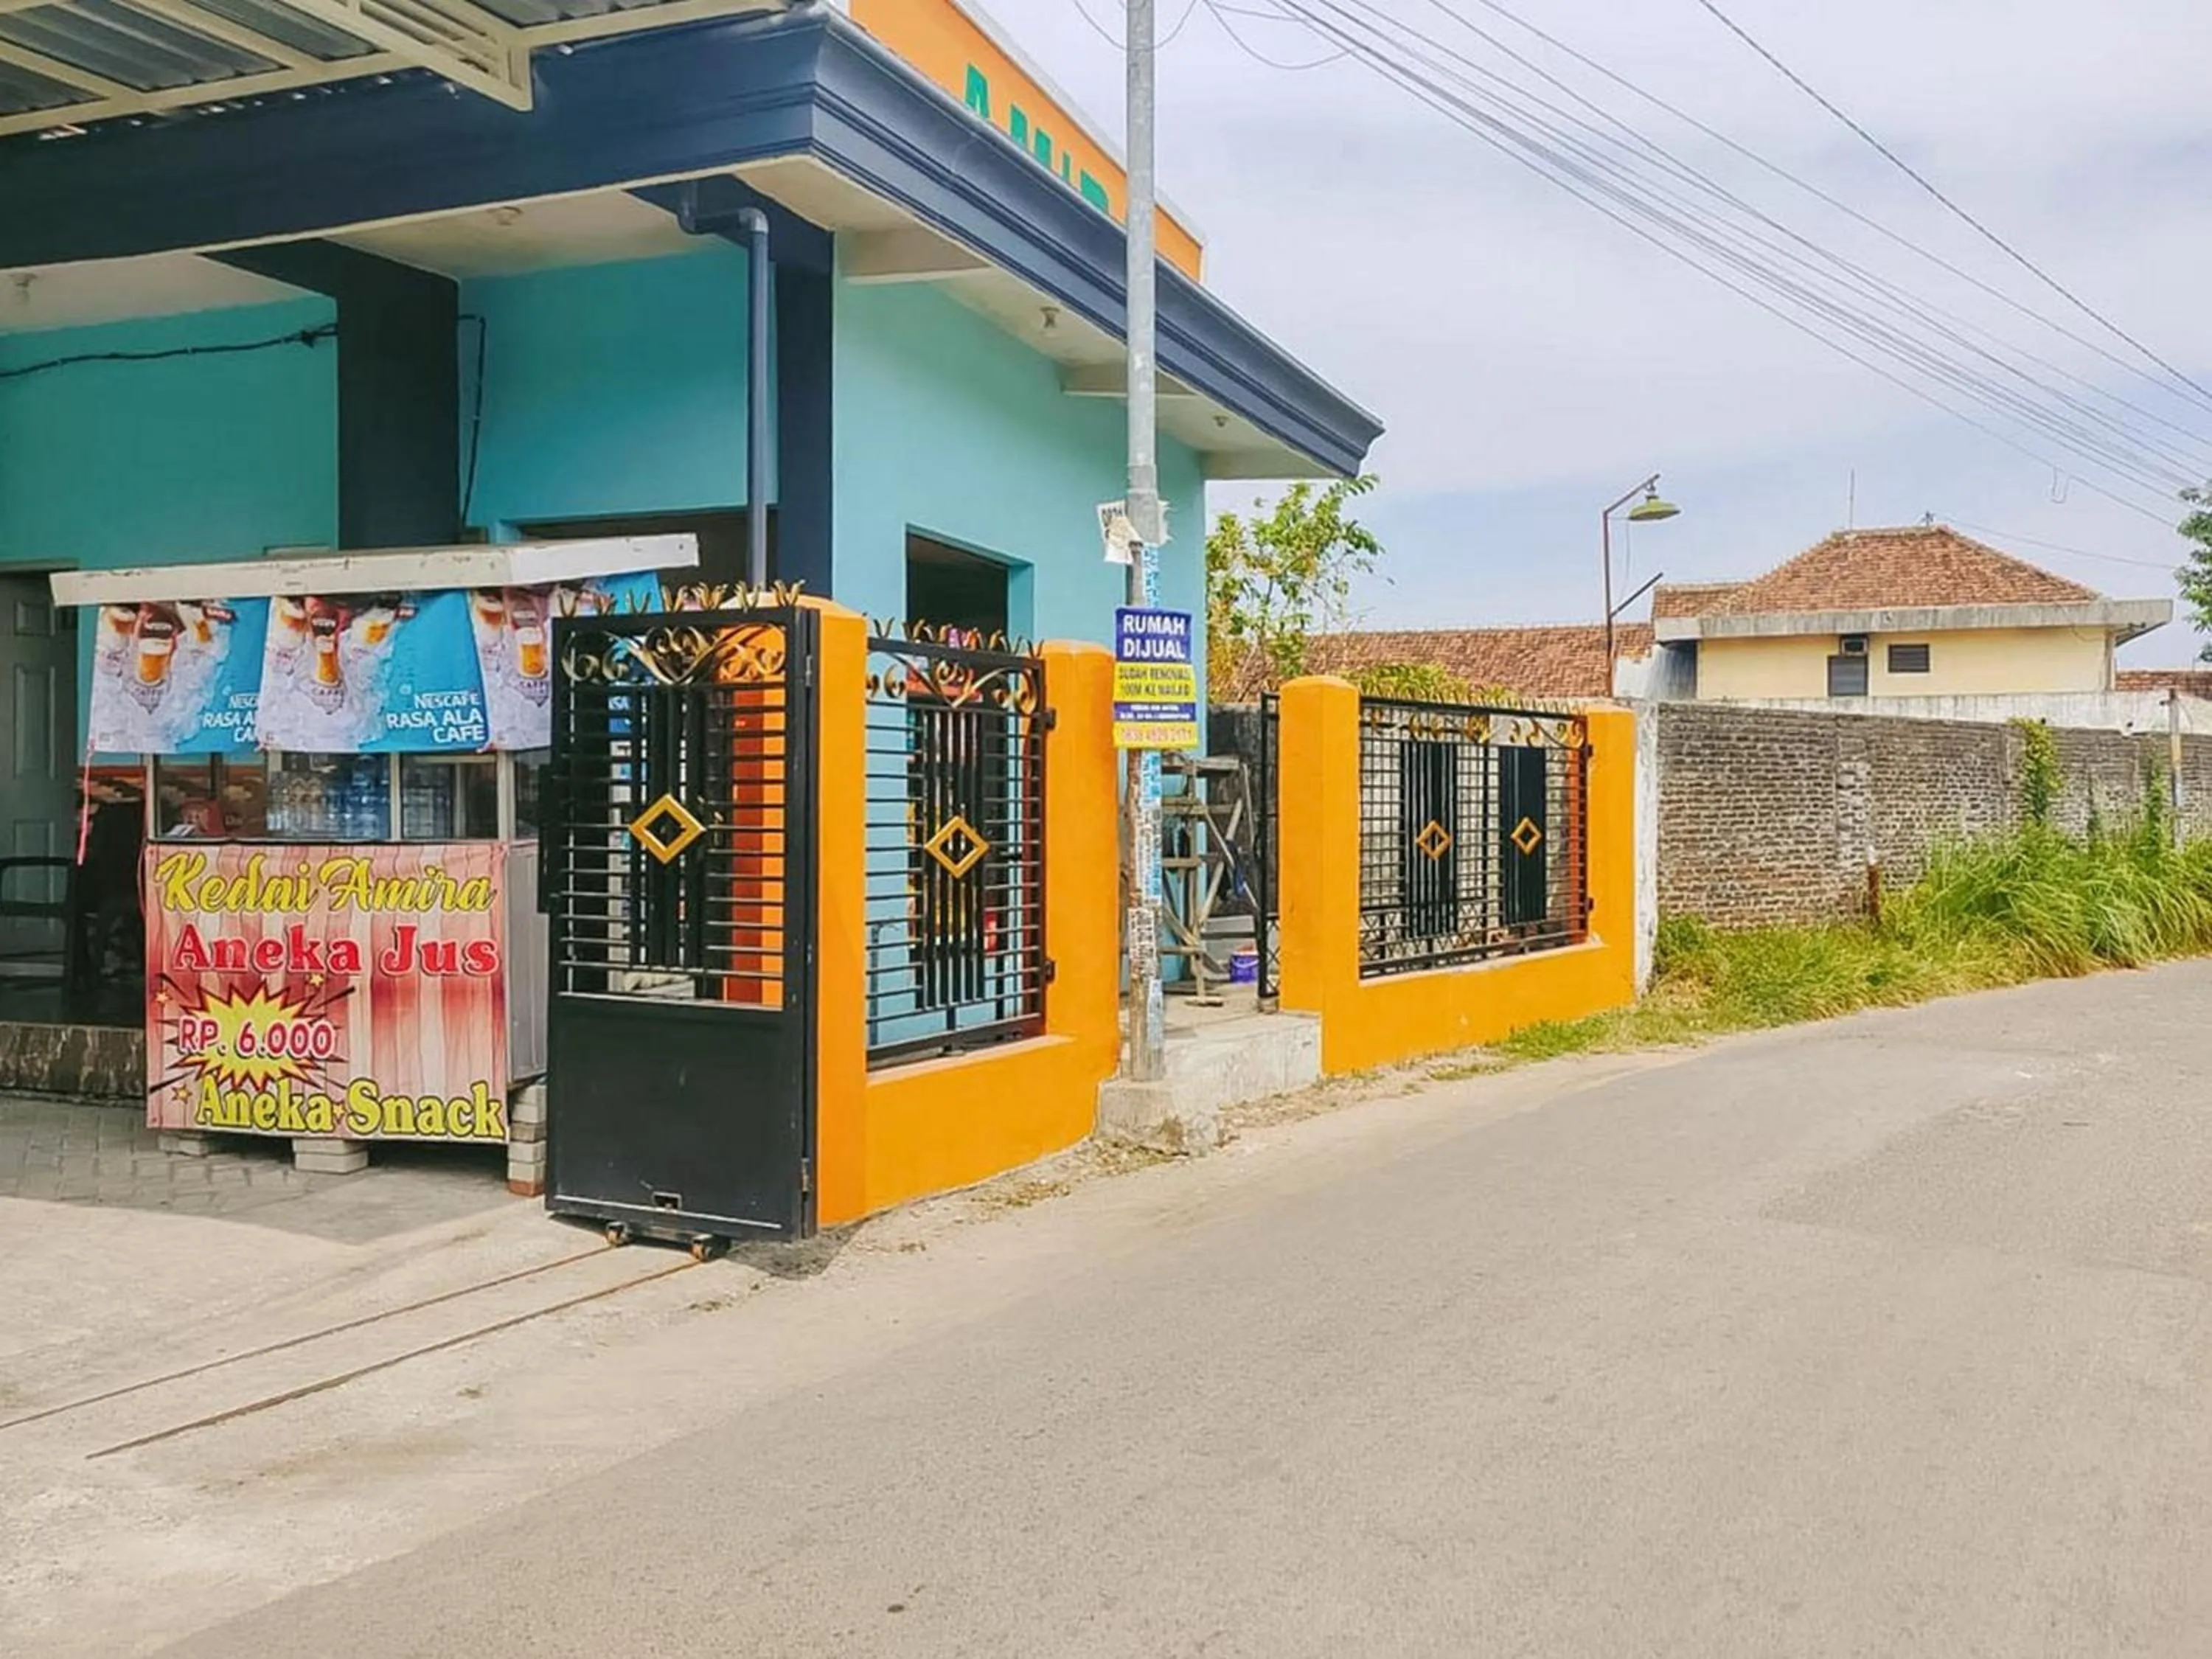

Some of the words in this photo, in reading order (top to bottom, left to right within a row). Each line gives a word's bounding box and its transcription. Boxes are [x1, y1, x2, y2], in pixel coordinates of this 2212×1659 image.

[1123, 614, 1186, 636] RUMAH
[1123, 638, 1186, 658] DIJUAL
[202, 710, 240, 728] RASA
[386, 710, 437, 729] RASA
[442, 707, 484, 726] ALA
[433, 724, 485, 743] CAFE
[153, 851, 319, 914] Kedai
[318, 855, 498, 914] Amira
[173, 922, 363, 973] Aneka
[380, 924, 498, 975] Jus
[178, 1016, 227, 1055] RP.
[236, 1019, 335, 1058] 6.000
[195, 1072, 335, 1133] Aneka
[346, 1077, 506, 1139] Snack
